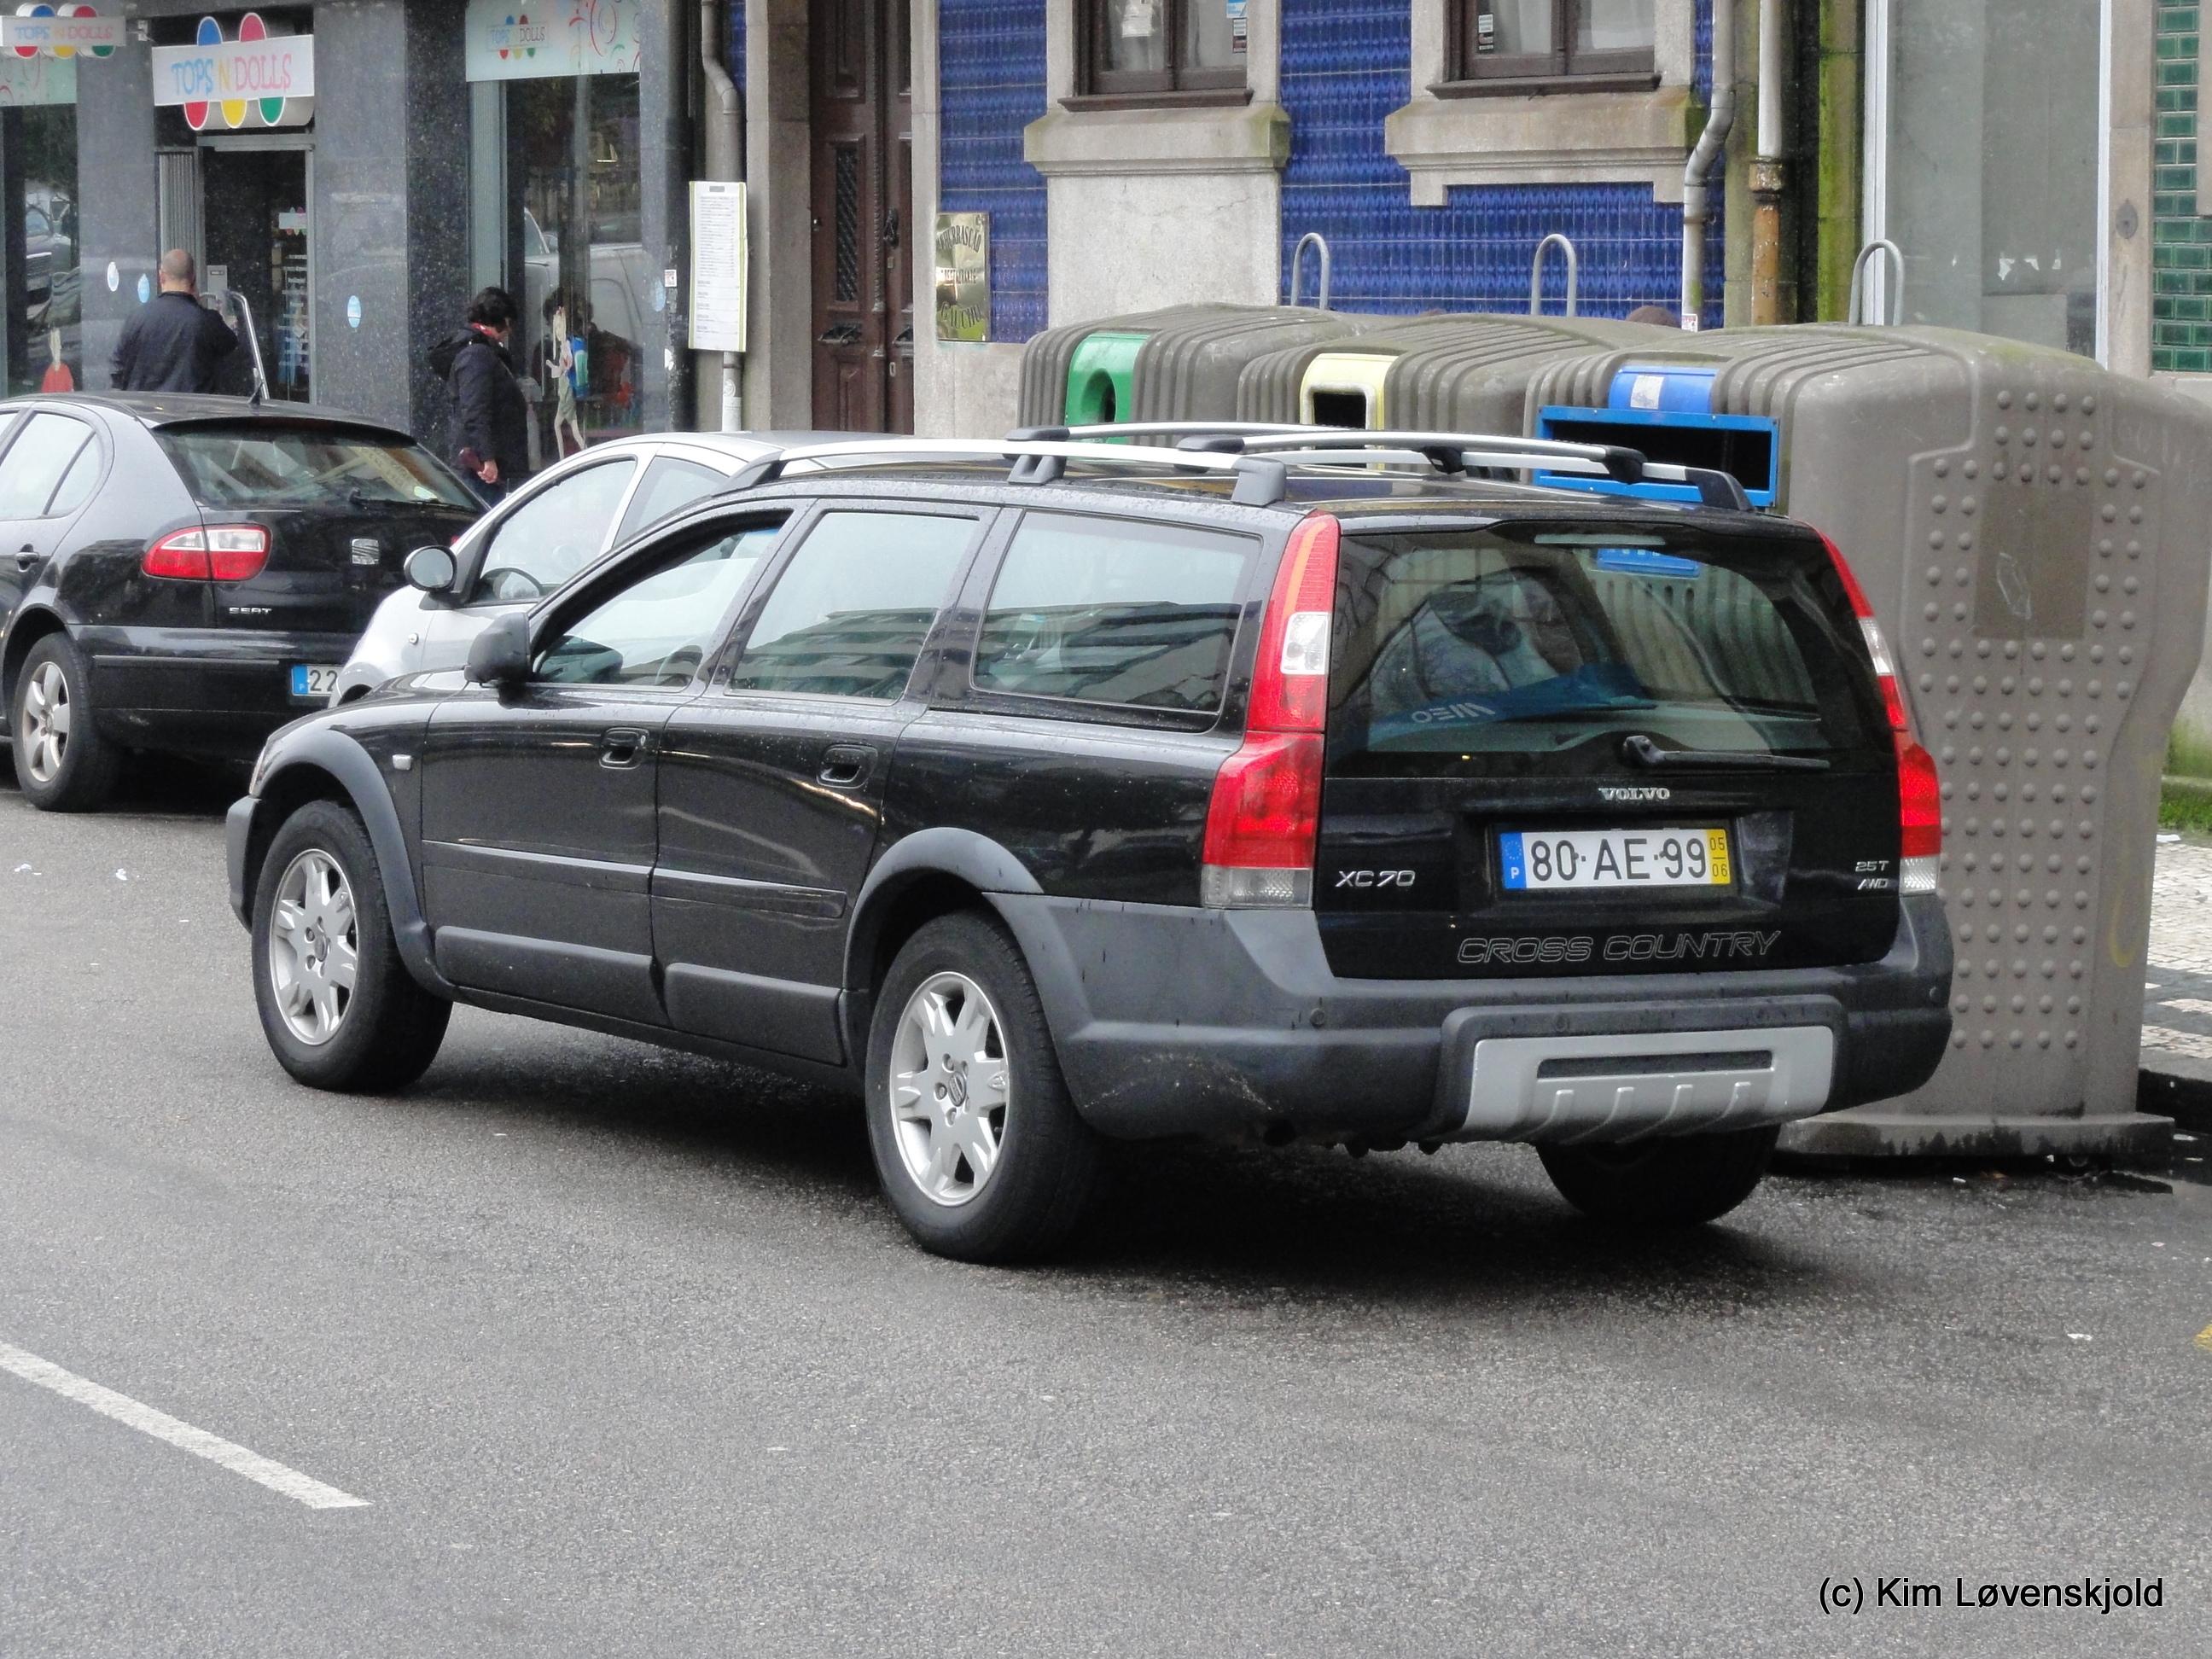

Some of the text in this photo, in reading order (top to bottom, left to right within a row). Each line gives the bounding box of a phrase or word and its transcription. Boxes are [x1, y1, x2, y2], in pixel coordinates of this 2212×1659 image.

[15, 26, 51, 39] TOPS
[68, 26, 113, 39] DOLLS
[491, 29, 510, 44] TOPS
[519, 26, 545, 42] DOLLS
[172, 53, 292, 96] TOPS N DOLLS
[309, 669, 338, 692] 22
[1598, 787, 1670, 801] VOLVO
[1709, 837, 1726, 852] 05
[1511, 866, 1520, 879] P
[1712, 863, 1728, 878] 06
[1857, 878, 1889, 890] AWD
[1458, 931, 1782, 963] CROSS COUNTRY
